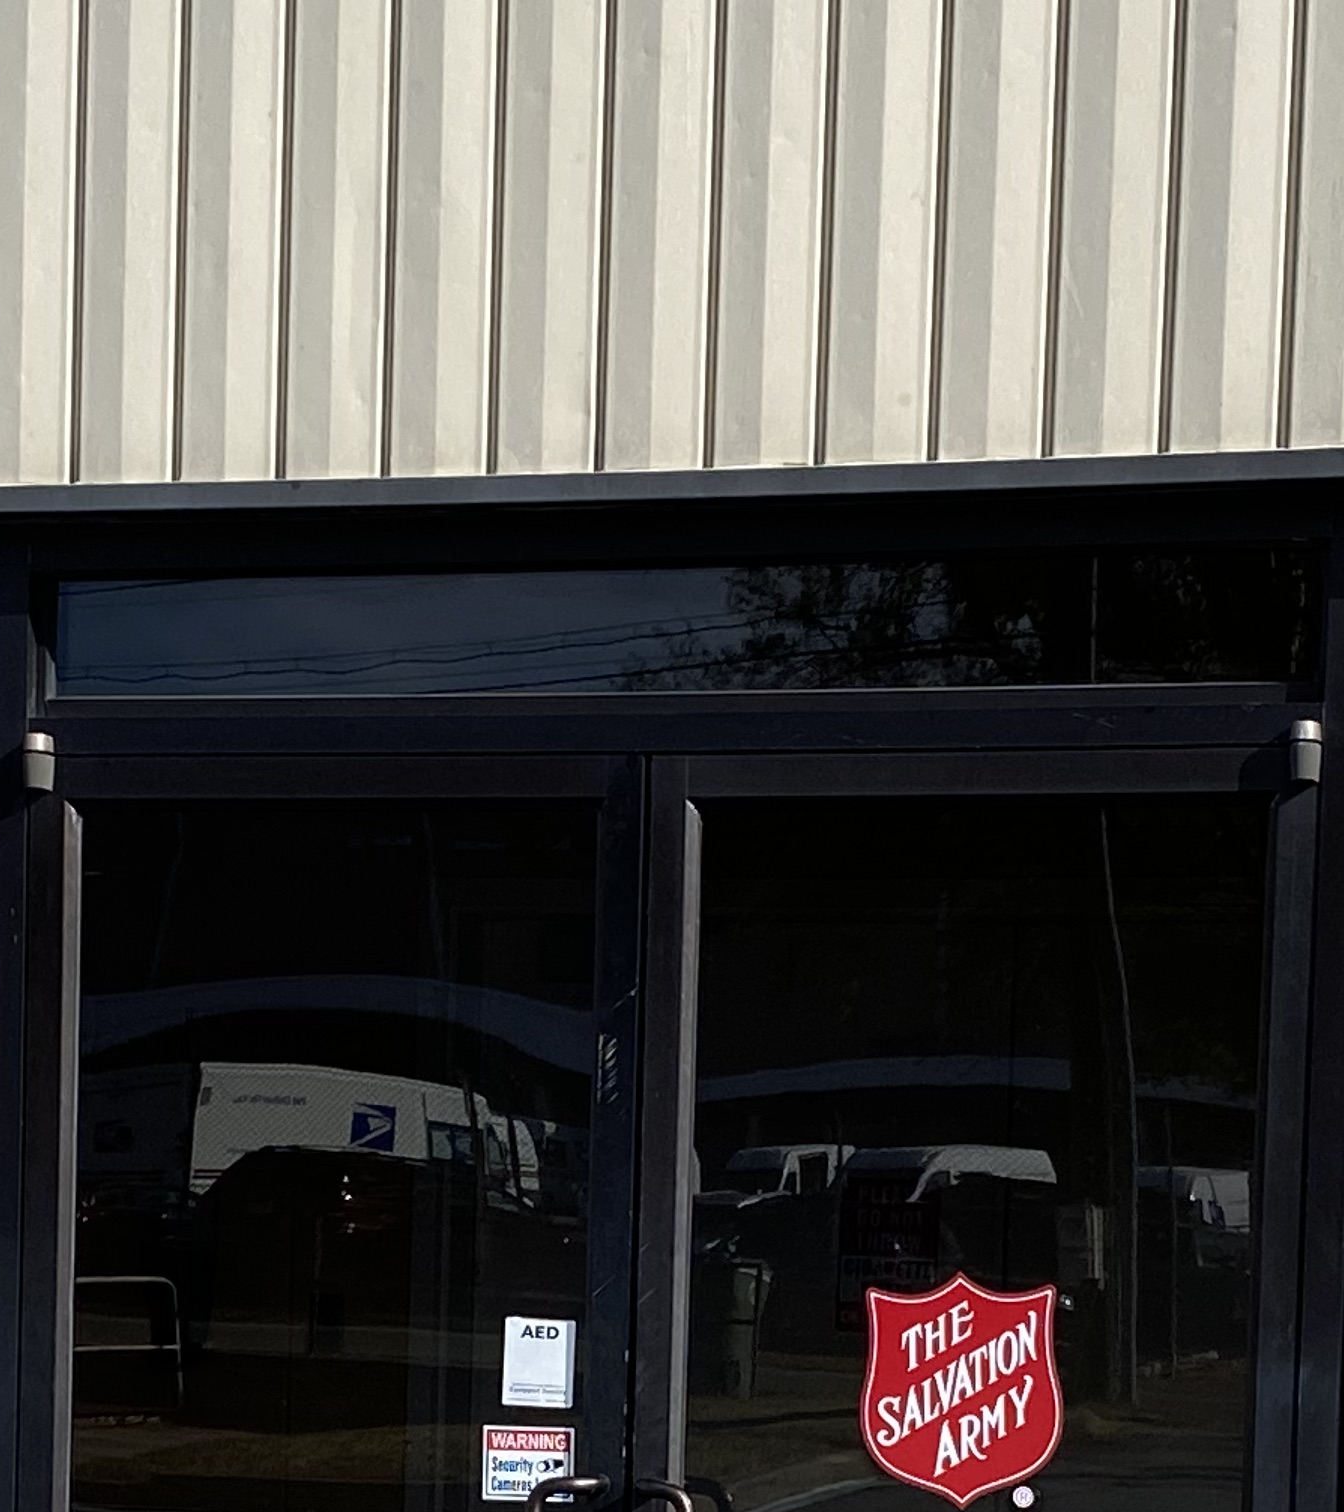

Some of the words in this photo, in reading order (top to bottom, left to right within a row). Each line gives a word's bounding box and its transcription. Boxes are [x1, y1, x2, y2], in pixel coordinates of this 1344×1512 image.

[521, 1325, 560, 1340] AED
[900, 1299, 976, 1374] THE
[876, 1310, 1038, 1448] SALVATION
[933, 1374, 1035, 1478] ARMY
[491, 1431, 567, 1450] WARNING
[492, 1456, 534, 1476] Security
[491, 1475, 532, 1492] Cameras
